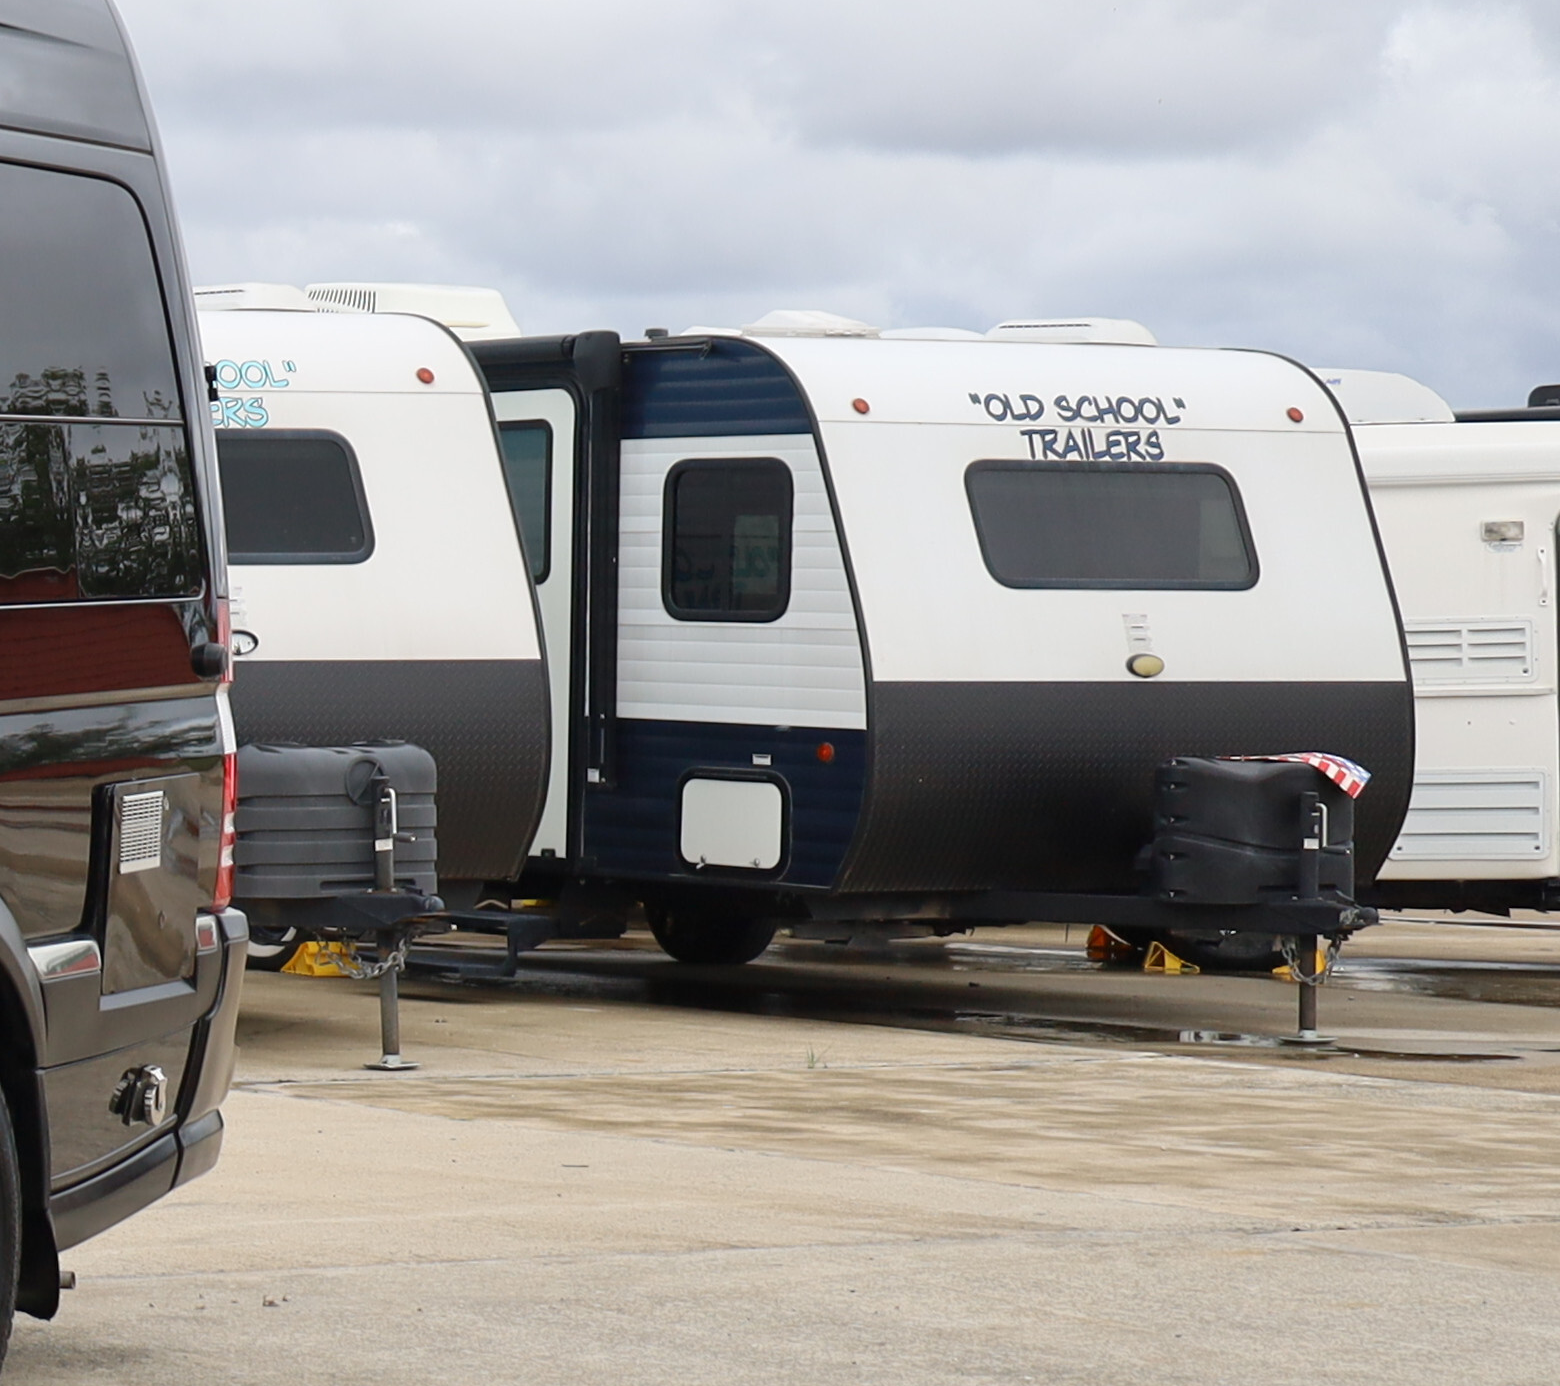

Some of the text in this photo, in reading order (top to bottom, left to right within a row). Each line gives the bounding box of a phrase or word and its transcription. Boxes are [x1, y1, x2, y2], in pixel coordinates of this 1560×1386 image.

[213, 359, 297, 389] OOL"
[968, 392, 1187, 425] "OLD SCHOOL"
[1019, 427, 1165, 461] TRAILERS
